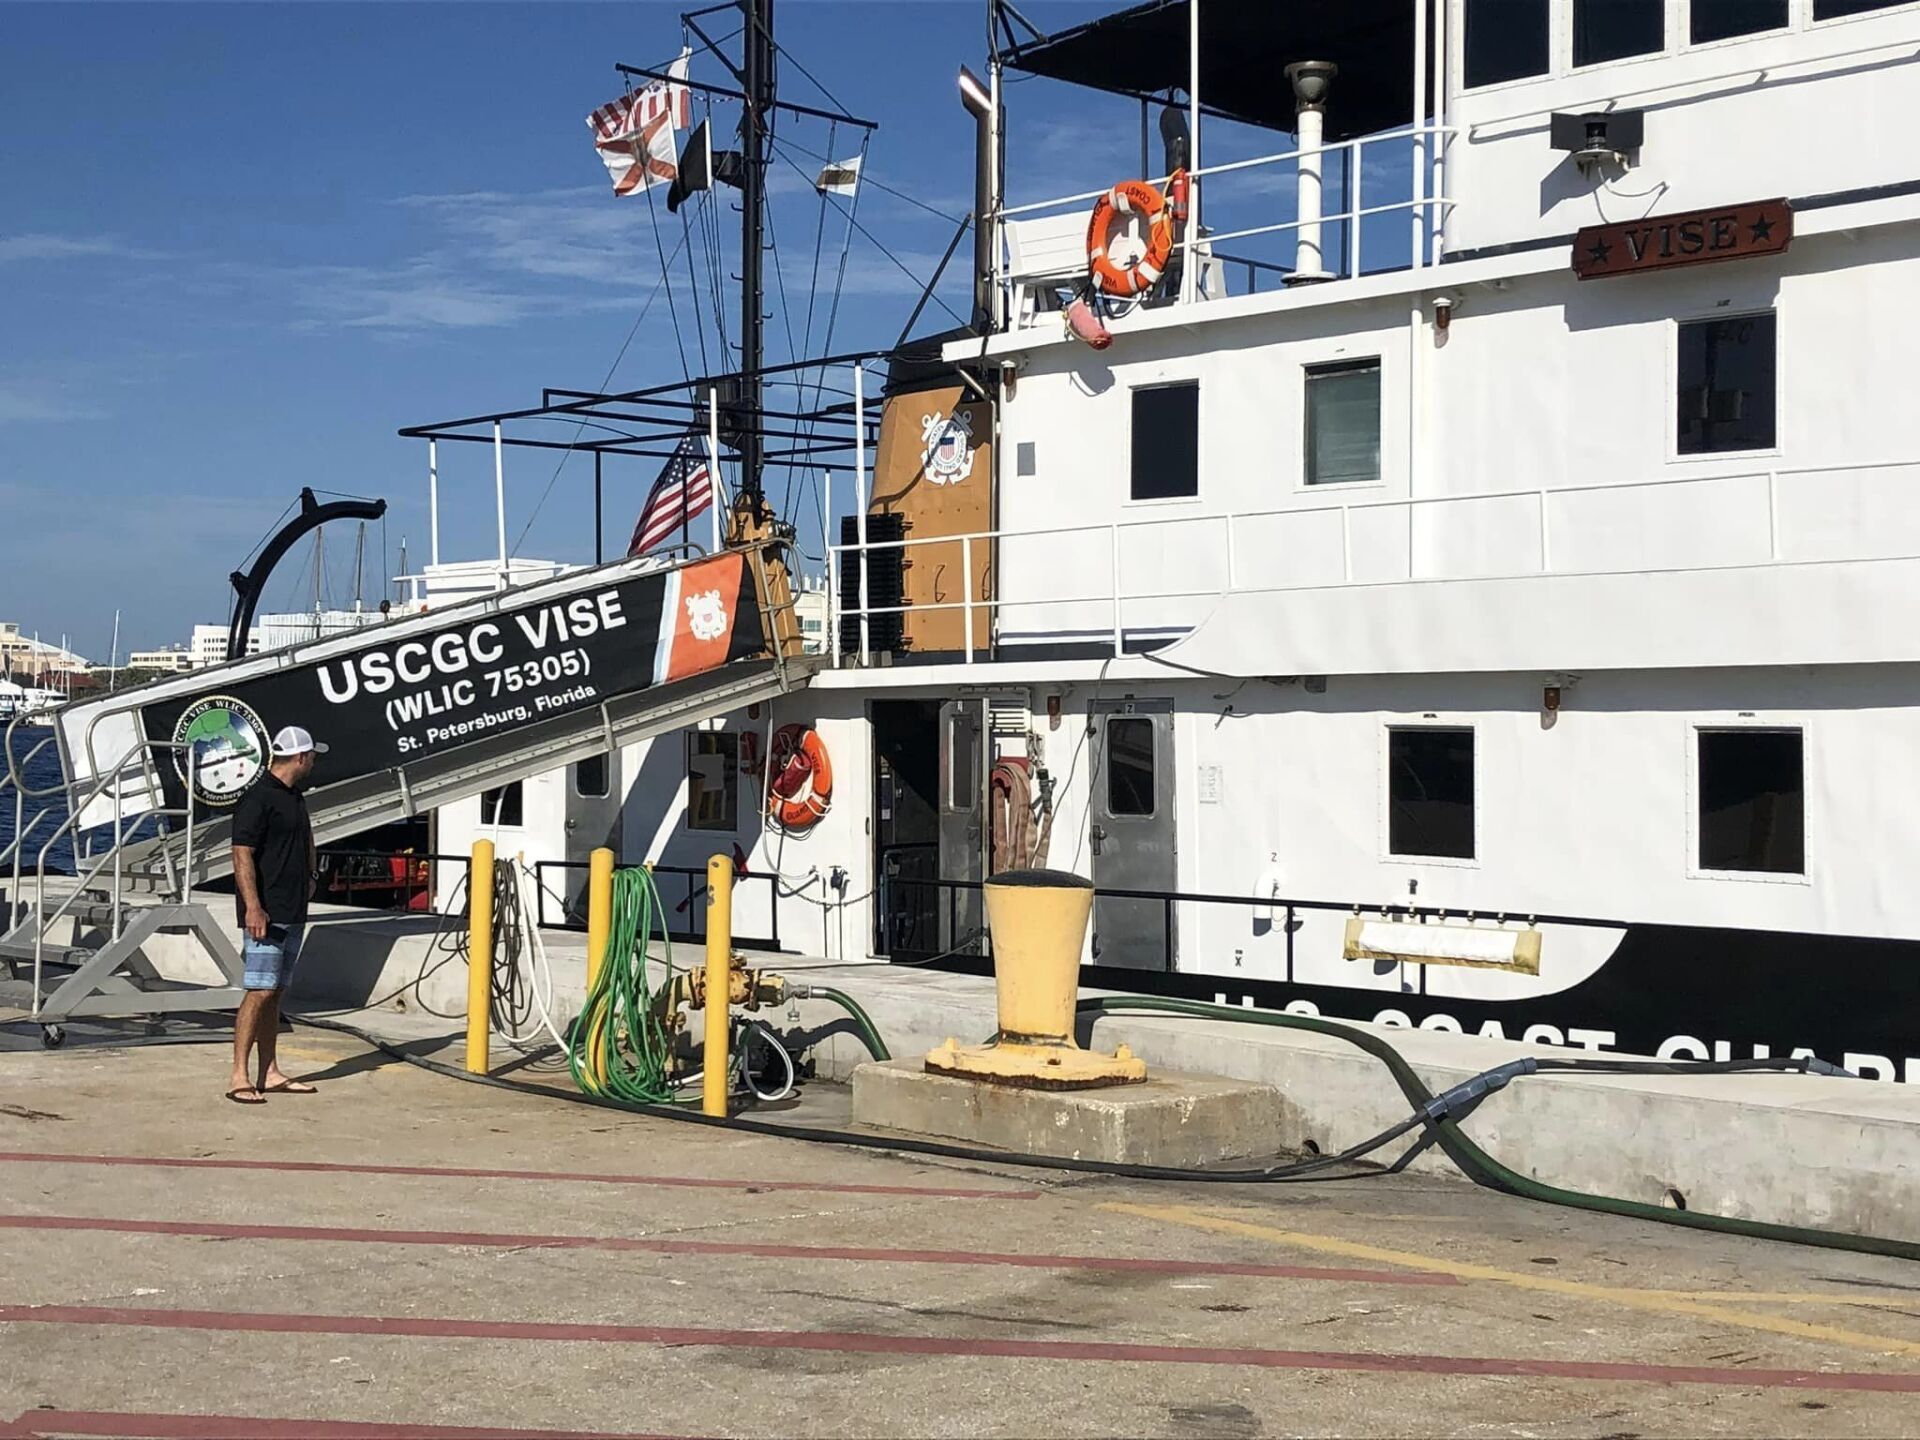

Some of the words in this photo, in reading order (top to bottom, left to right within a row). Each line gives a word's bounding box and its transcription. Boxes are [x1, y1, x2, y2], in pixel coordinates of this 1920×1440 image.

[1624, 214, 1738, 261] VISE
[316, 622, 504, 704] USCGC
[514, 590, 627, 649] VISE
[189, 702, 212, 718] VISE
[215, 700, 242, 713] WLIC
[243, 710, 263, 734] 75305
[385, 679, 477, 731] (WLIC
[484, 648, 591, 698] 75305)
[397, 736, 423, 752] St.
[426, 704, 533, 743] Petersburg,
[534, 684, 597, 712] Florida
